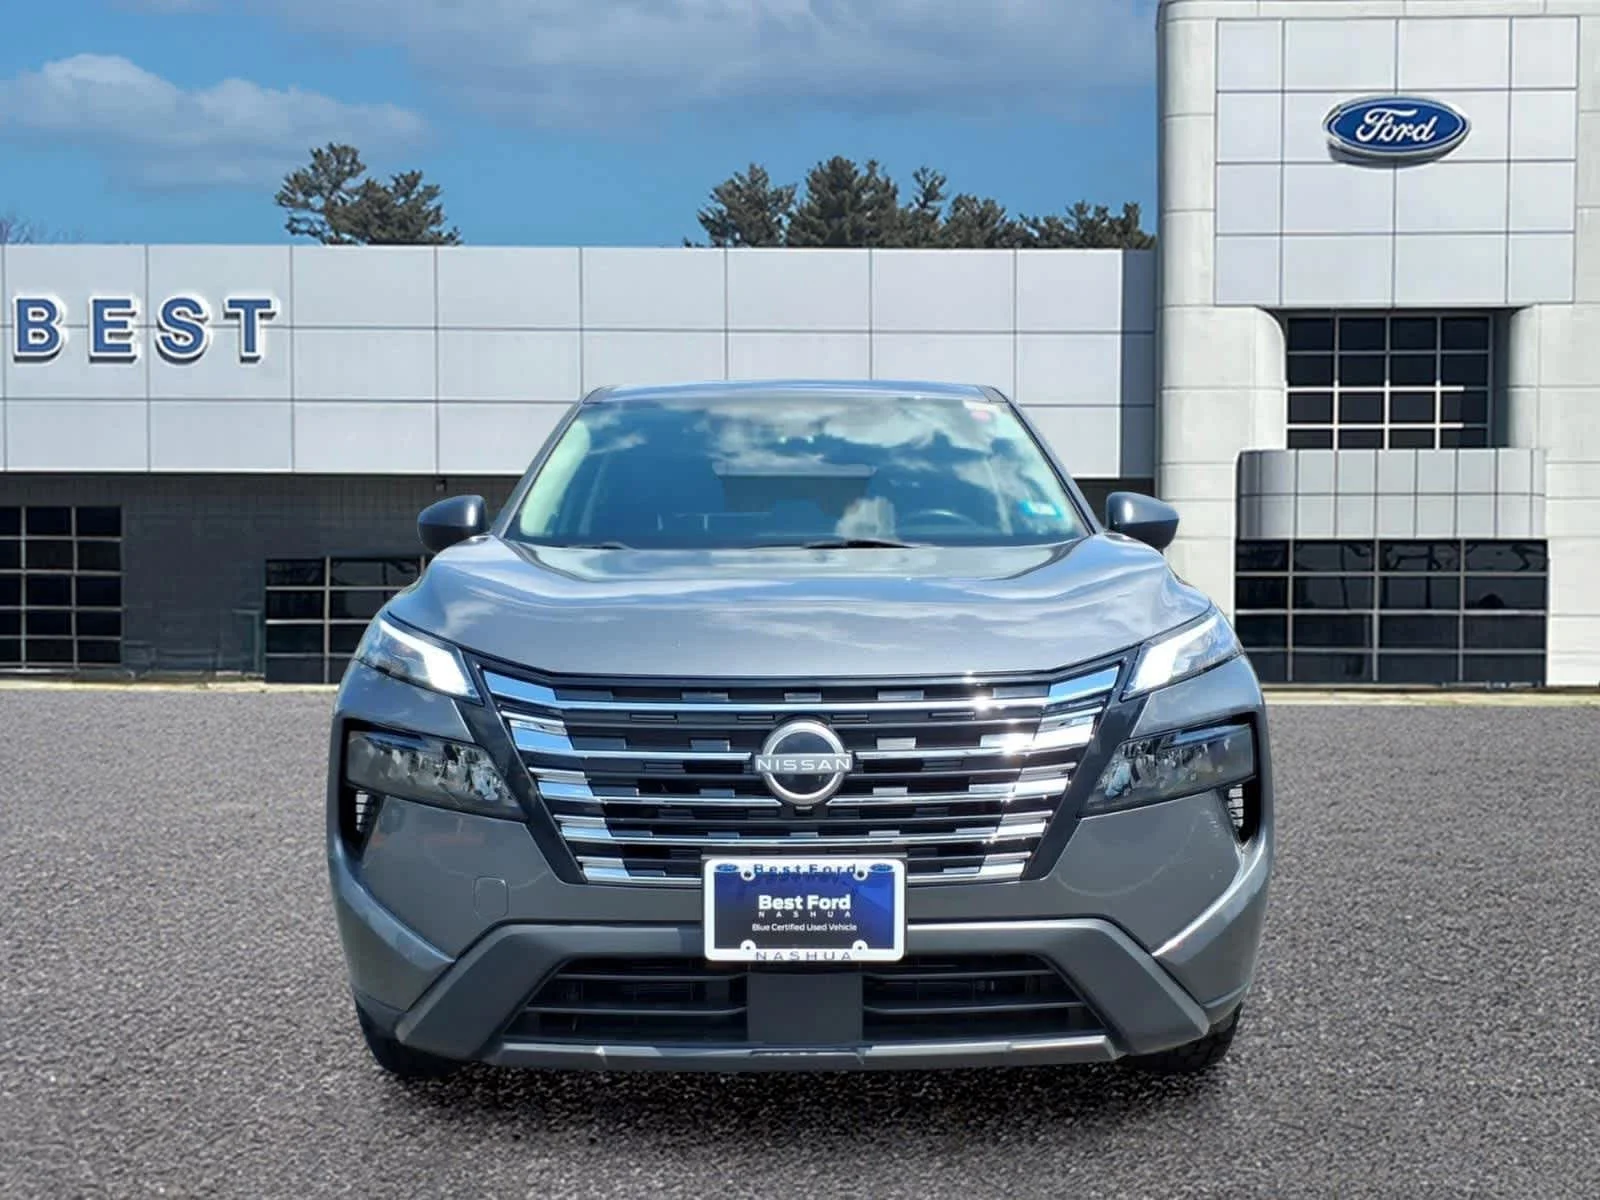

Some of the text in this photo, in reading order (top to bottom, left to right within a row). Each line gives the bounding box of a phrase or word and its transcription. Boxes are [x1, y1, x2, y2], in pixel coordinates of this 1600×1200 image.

[1355, 108, 1439, 143] Ford
[14, 295, 275, 358] BEST
[757, 758, 850, 771] NISSAN
[753, 863, 802, 875] Best
[808, 863, 856, 875] Ford
[758, 893, 851, 910] Best Ford
[752, 923, 857, 931] Blue Certified Used Vehicle
[755, 951, 852, 961] NASHUA
